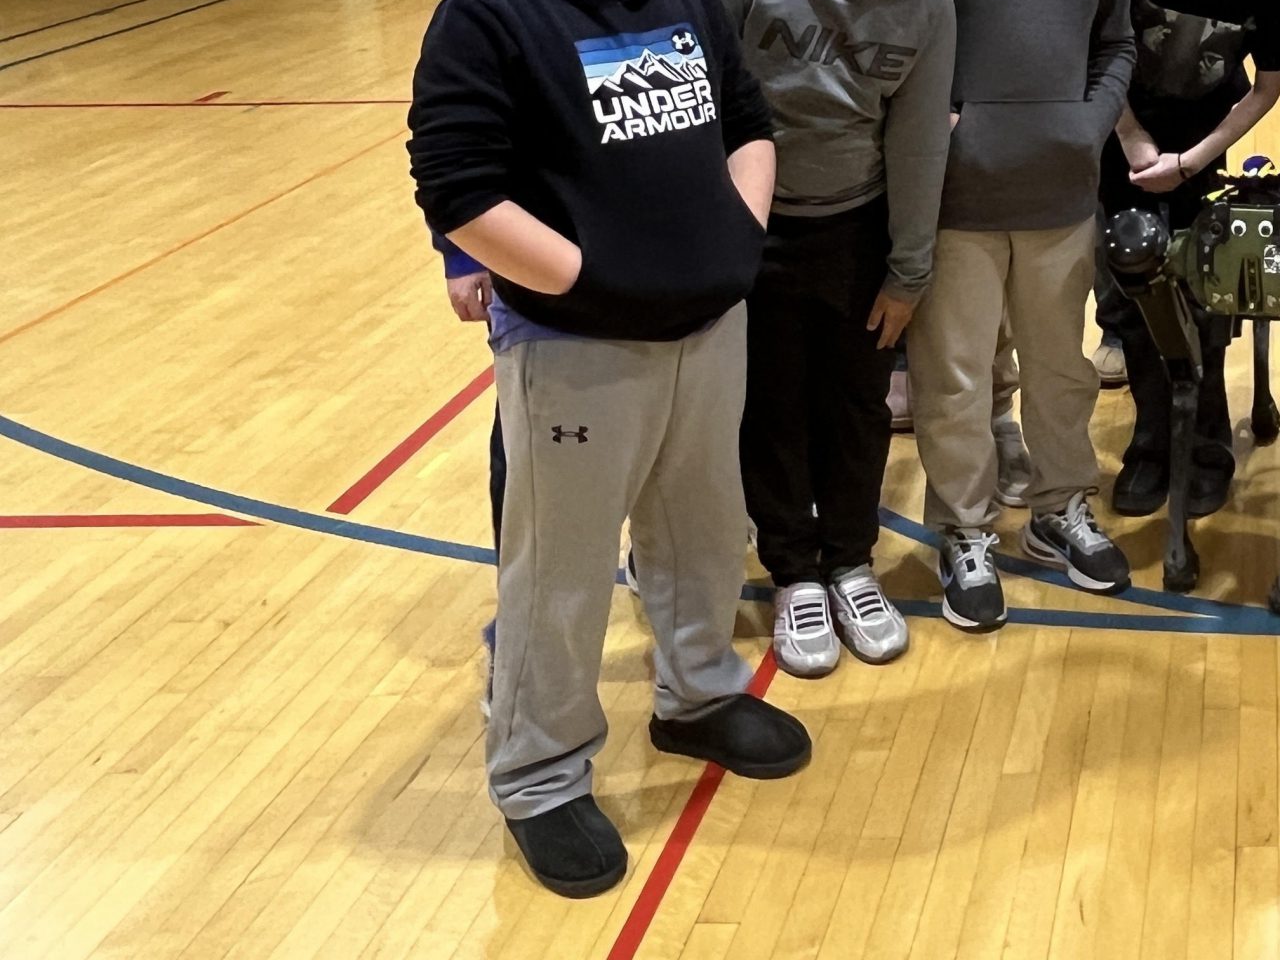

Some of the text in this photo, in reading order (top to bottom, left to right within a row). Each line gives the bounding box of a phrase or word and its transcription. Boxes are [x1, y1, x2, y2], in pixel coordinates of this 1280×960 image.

[758, 18, 918, 81] NIKE
[592, 79, 713, 124] UNDER
[601, 102, 717, 145] ARMOUR
